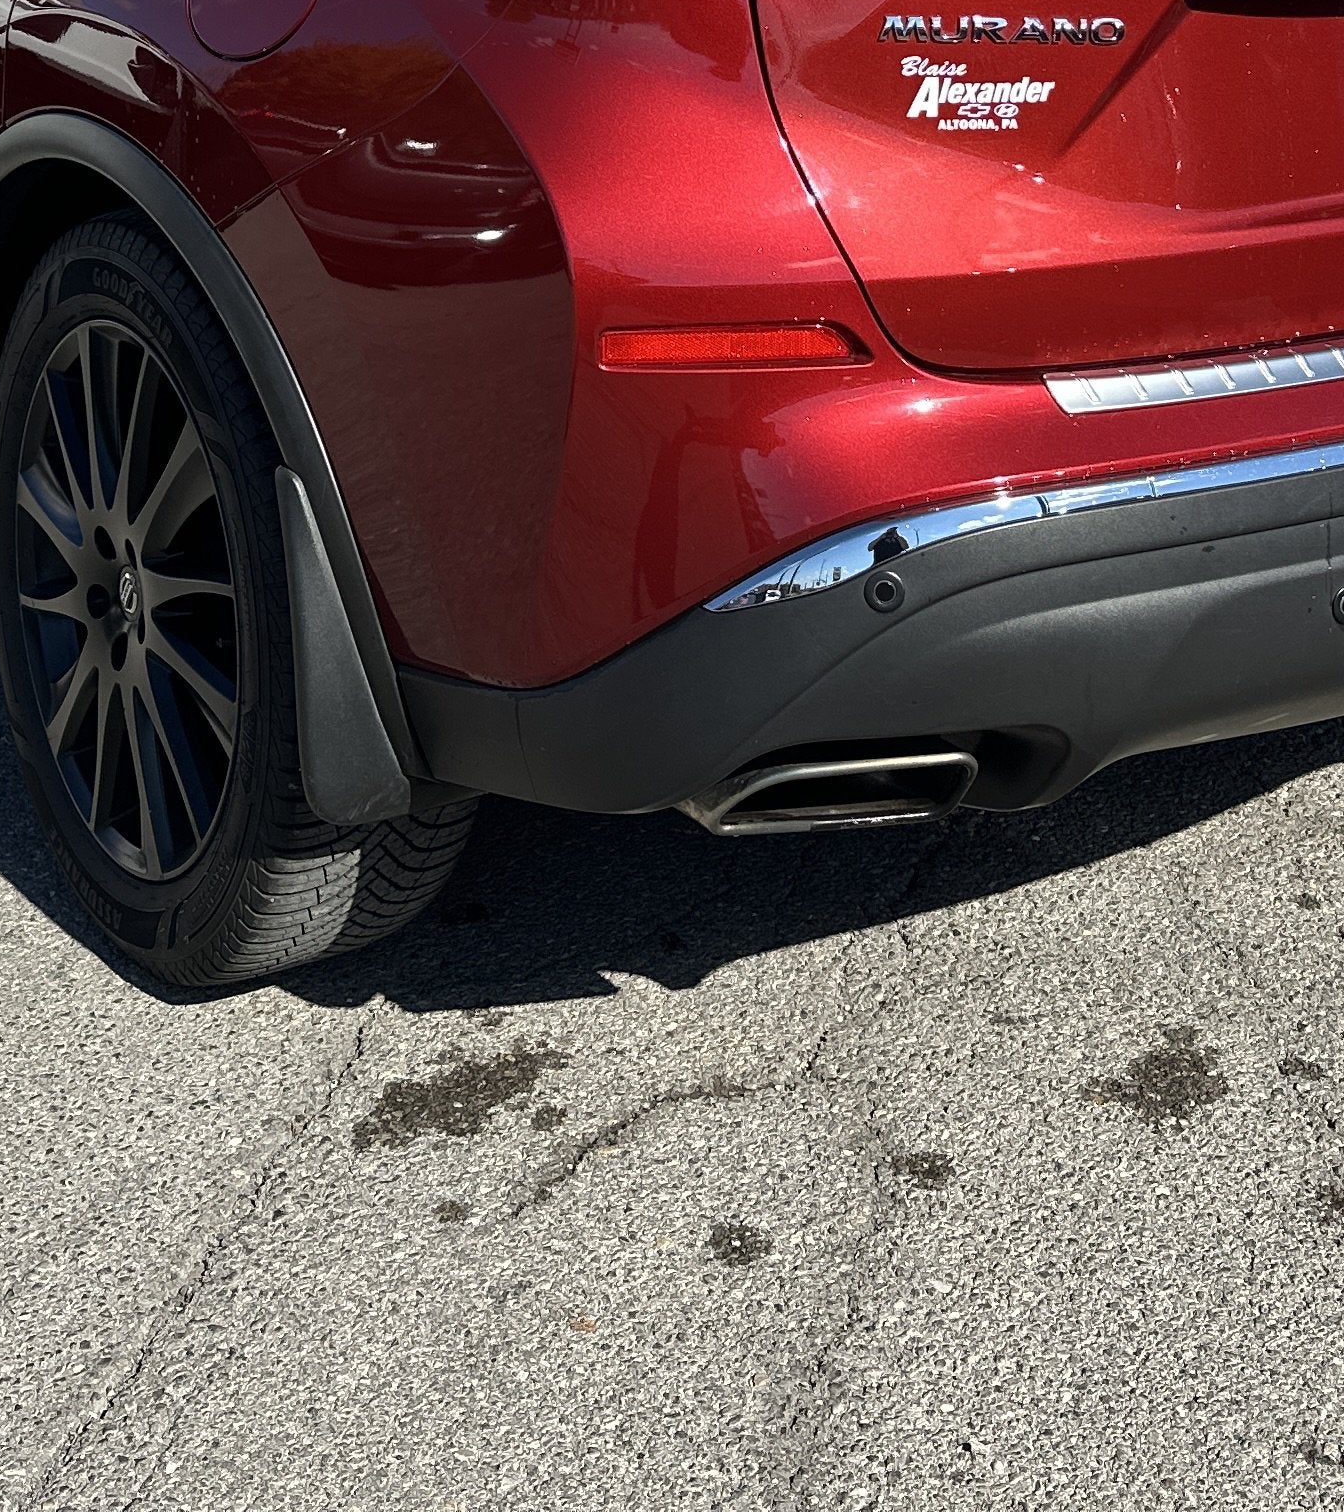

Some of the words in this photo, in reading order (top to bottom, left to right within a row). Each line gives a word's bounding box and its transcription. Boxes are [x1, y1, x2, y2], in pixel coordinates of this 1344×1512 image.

[877, 15, 1127, 45] MURANO
[900, 56, 967, 76] Blaise
[906, 76, 1056, 118] Alexander
[937, 119, 999, 131] ALTOONA,
[1002, 118, 1018, 130] PA
[91, 266, 173, 351] GOODYEAR
